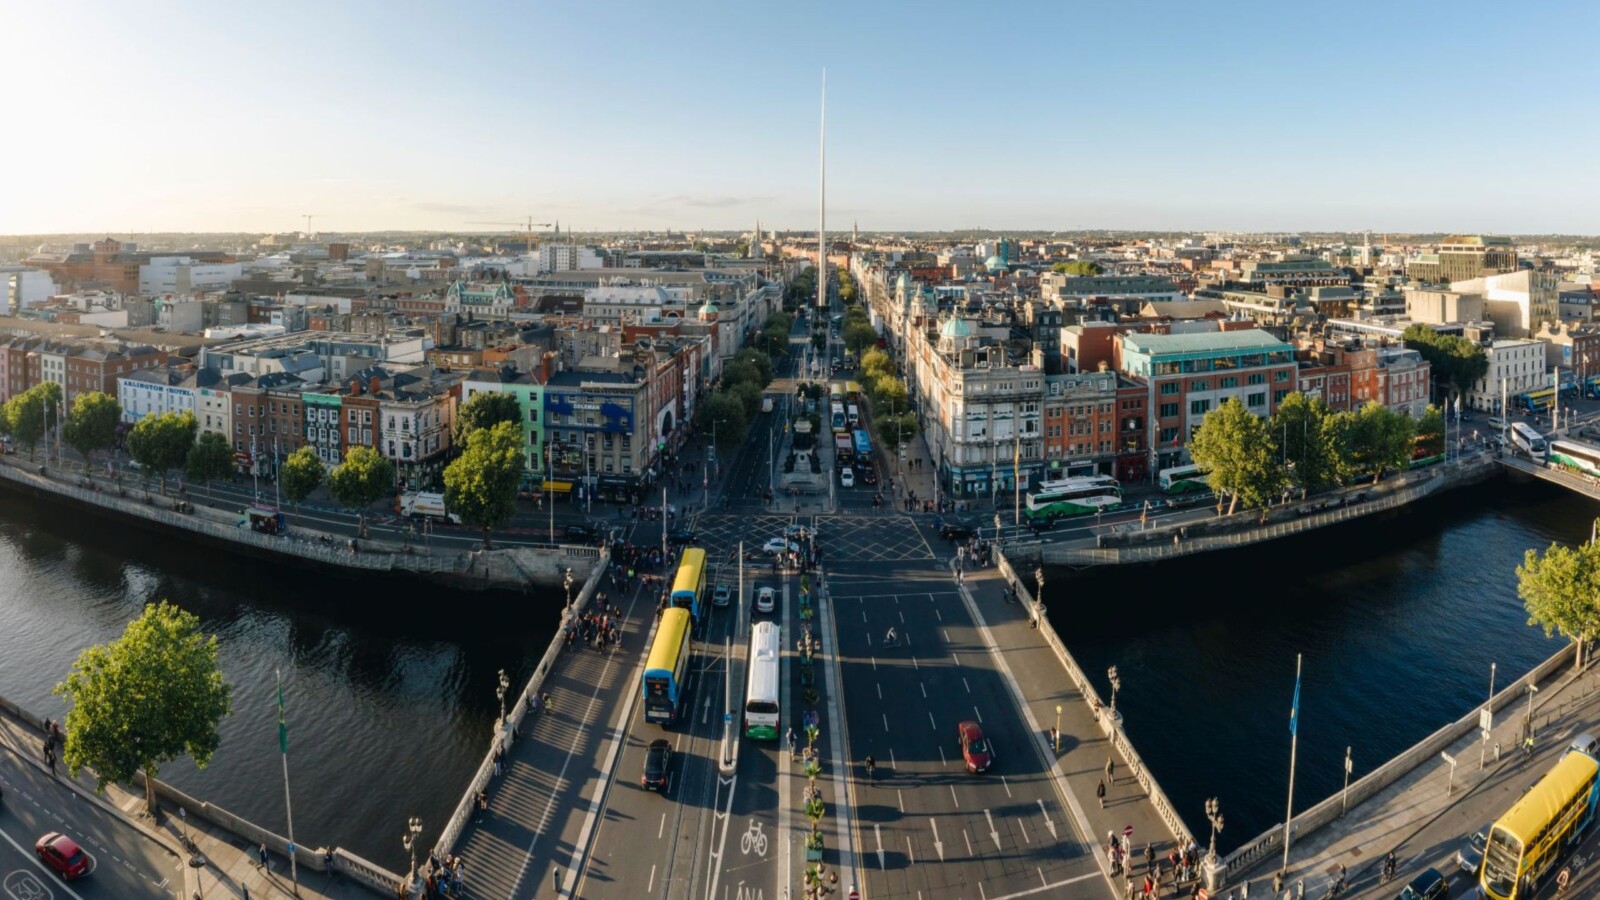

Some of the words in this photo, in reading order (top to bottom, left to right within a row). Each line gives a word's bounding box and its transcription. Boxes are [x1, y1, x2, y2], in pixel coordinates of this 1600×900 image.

[123, 381, 164, 392] ARLINGTON
[169, 388, 191, 396] HOTEL
[10, 877, 41, 900] 30
